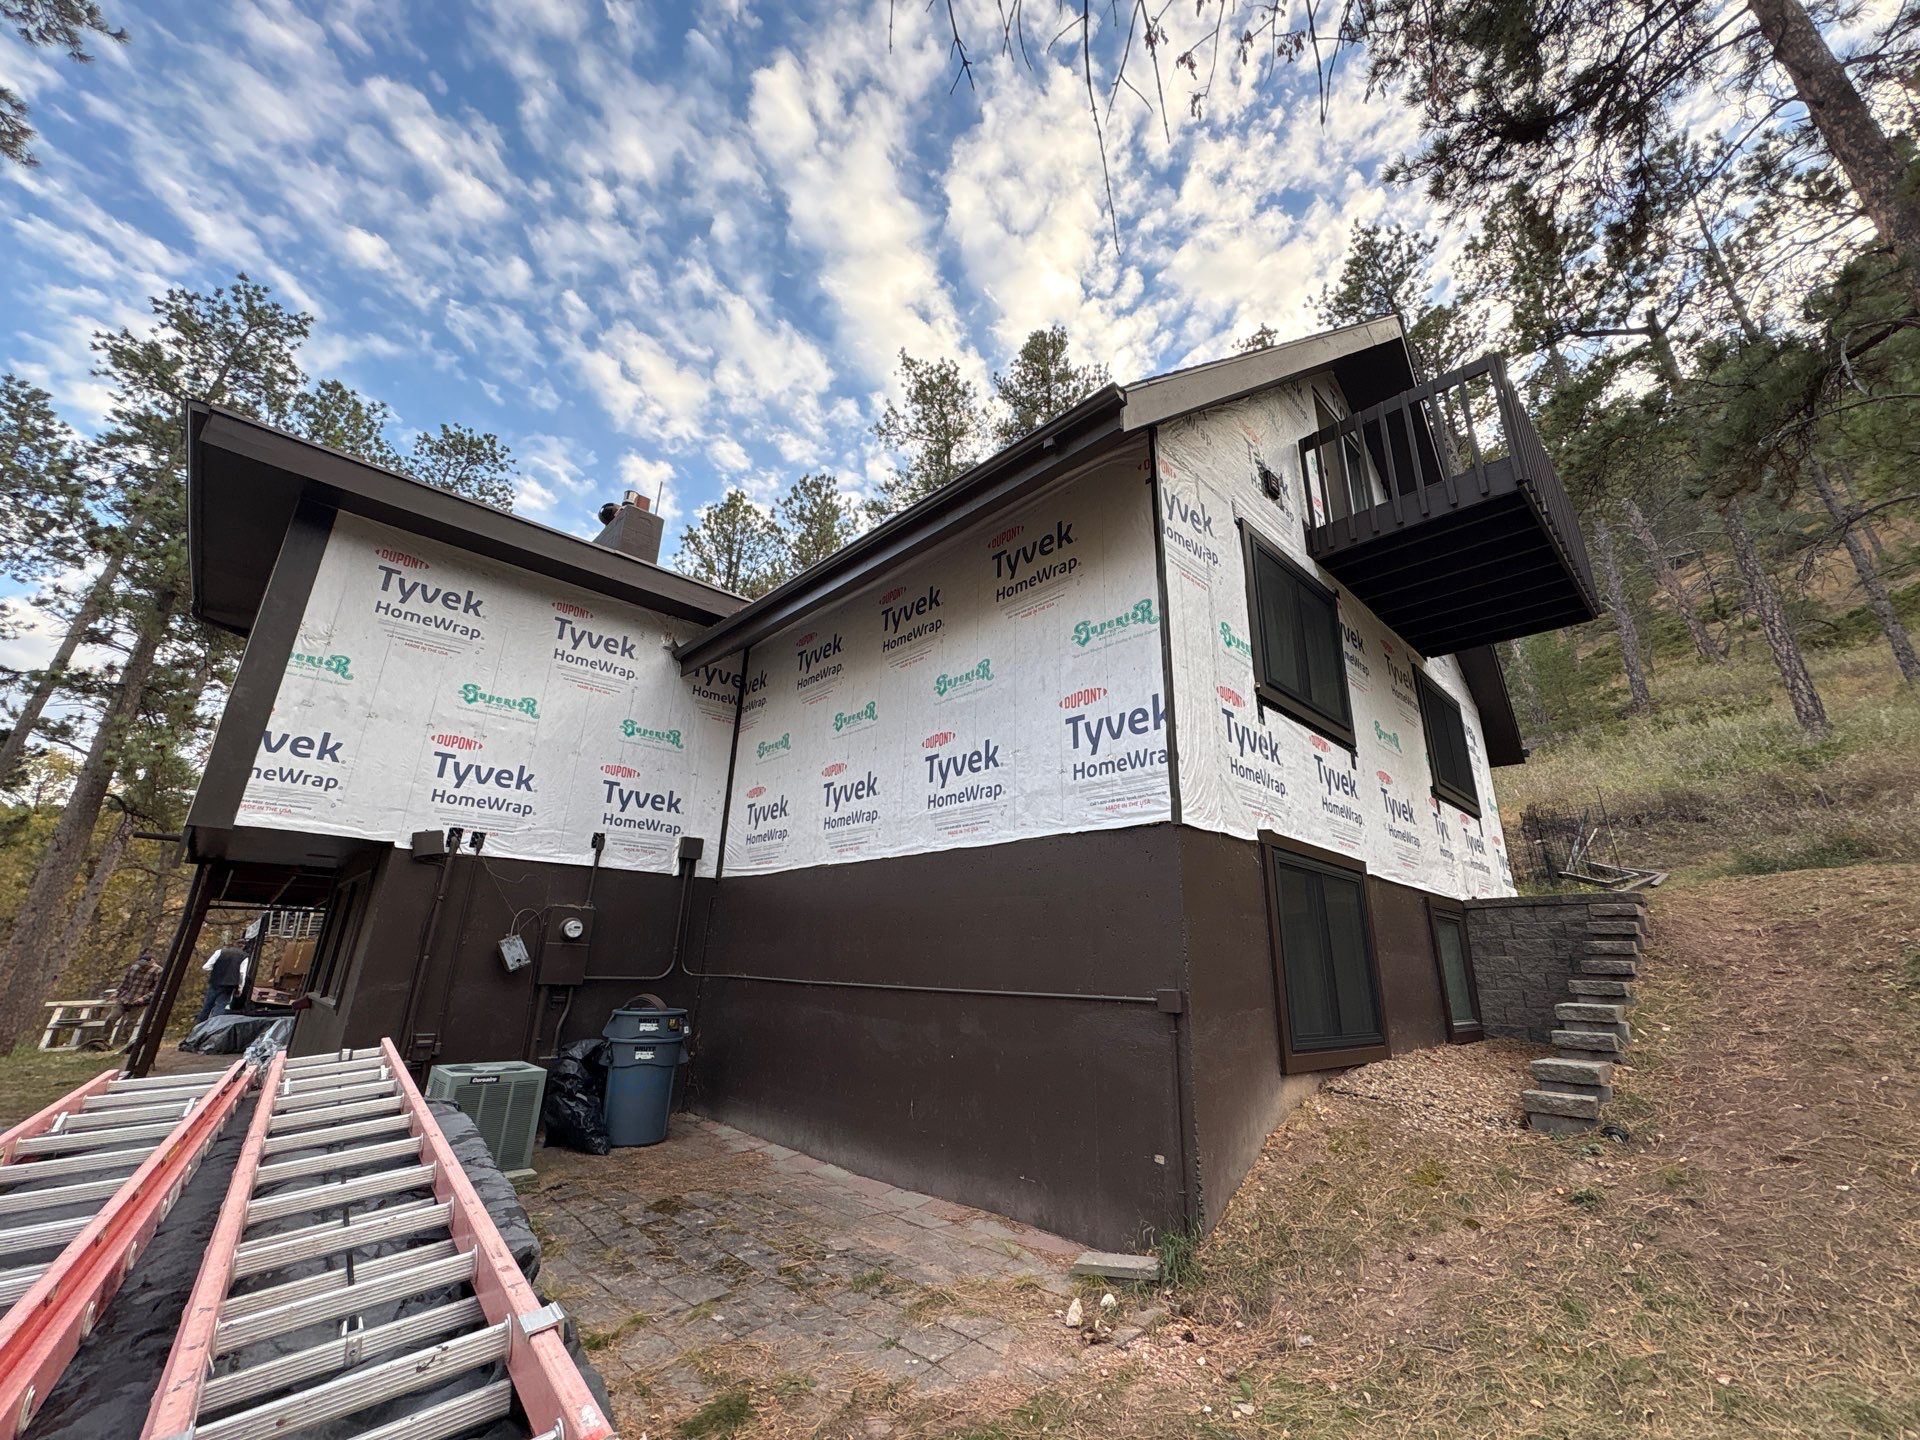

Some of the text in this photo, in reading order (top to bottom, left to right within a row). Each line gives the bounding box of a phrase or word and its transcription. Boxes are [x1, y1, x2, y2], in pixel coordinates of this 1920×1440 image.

[991, 525, 1021, 549] DUPONT
[992, 520, 1077, 579] Tyvek
[382, 549, 424, 569] DUPONT
[378, 565, 484, 618] Tyvek
[996, 556, 1078, 603] HomeWrap
[374, 601, 482, 640] HomeWrap
[557, 602, 591, 619] DUPONT
[881, 585, 942, 634] Tyvek
[554, 617, 637, 659] Tyvek
[882, 617, 943, 653] HomeWrap
[553, 648, 636, 680] HomeWrap
[797, 633, 843, 674] Tyvek
[796, 661, 843, 691] HomeWrap
[1064, 687, 1102, 709] DUPONT
[436, 734, 479, 750] DUPONT
[925, 731, 953, 749] DUPONT
[1222, 708, 1281, 766] Tyvek
[433, 751, 535, 793] Tyvek
[604, 764, 638, 778] DUPONT
[925, 739, 1000, 789] Tyvek
[1229, 756, 1286, 798] HomeWrap
[1314, 753, 1358, 799] Tyvek
[431, 788, 533, 817] HomeWrap
[603, 779, 682, 814] Tyvek
[823, 771, 878, 813] Tyvek
[928, 783, 1002, 811] HomeWrap
[1381, 786, 1416, 826] Tyvek
[602, 812, 682, 837] HomeWrap
[747, 794, 789, 830] Tyvek
[823, 809, 879, 831] HomeWrap
[1322, 796, 1363, 827] HomeWrap
[746, 826, 788, 846] HomeWrap
